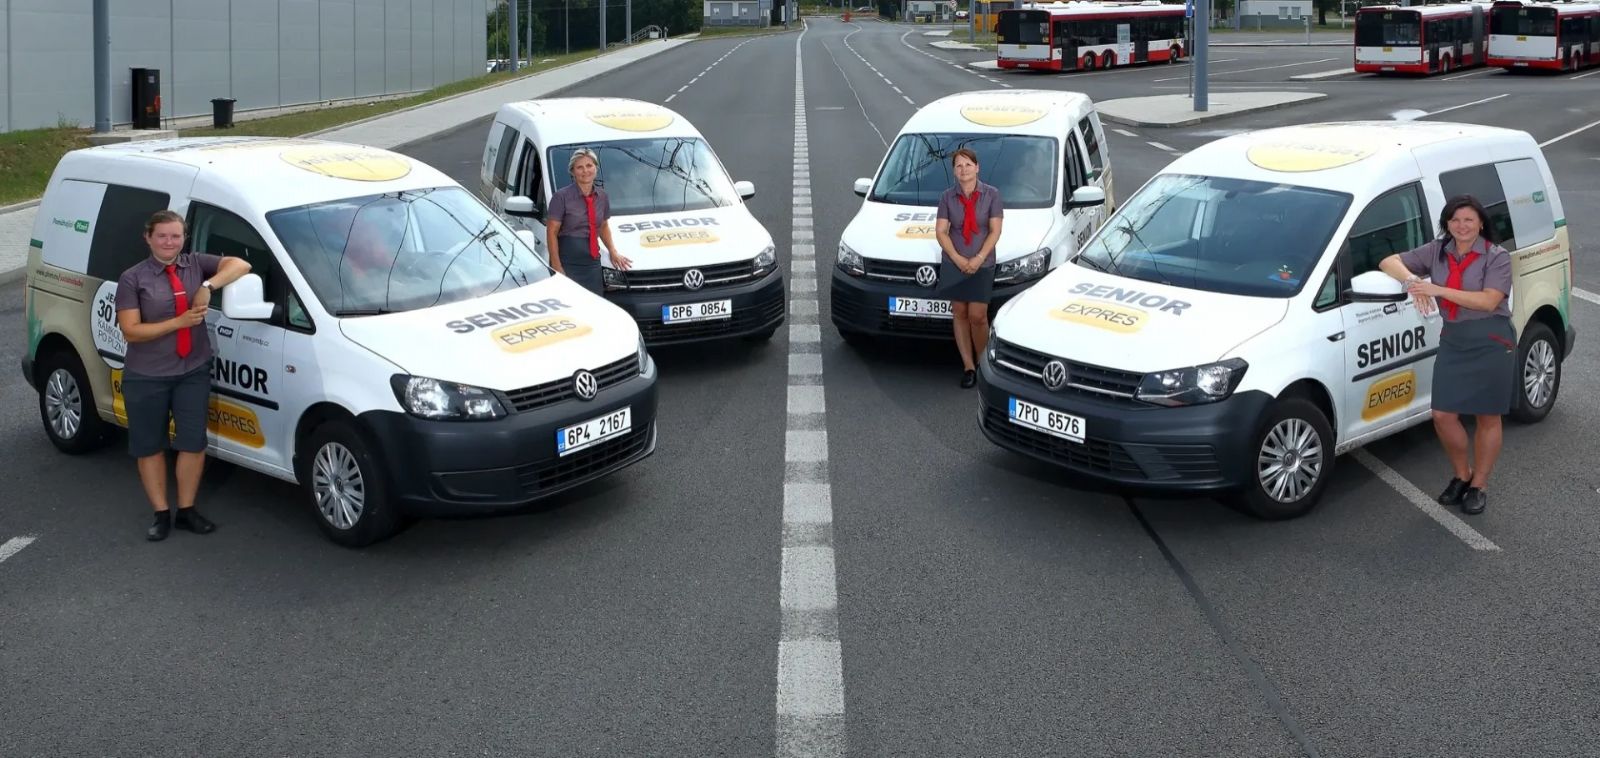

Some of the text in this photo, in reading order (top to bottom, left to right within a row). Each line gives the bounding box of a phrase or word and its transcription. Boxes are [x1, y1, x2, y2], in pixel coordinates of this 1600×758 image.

[618, 217, 720, 233] SENIOR
[646, 230, 710, 244] EXPRES
[98, 300, 113, 322] 30
[672, 302, 727, 318] 6P6 0854
[898, 299, 918, 312] 7P3
[1068, 282, 1192, 316] SENIOR
[446, 298, 573, 334] SENIOR
[1062, 303, 1139, 326] EXPRES
[500, 319, 577, 345] EXPRES
[1357, 325, 1426, 369] SENIOR
[1368, 380, 1412, 409] EXPRES
[208, 408, 256, 435] EXPRES
[568, 411, 626, 446] 6P4 2167
[1018, 402, 1080, 435] 7P0 6576
